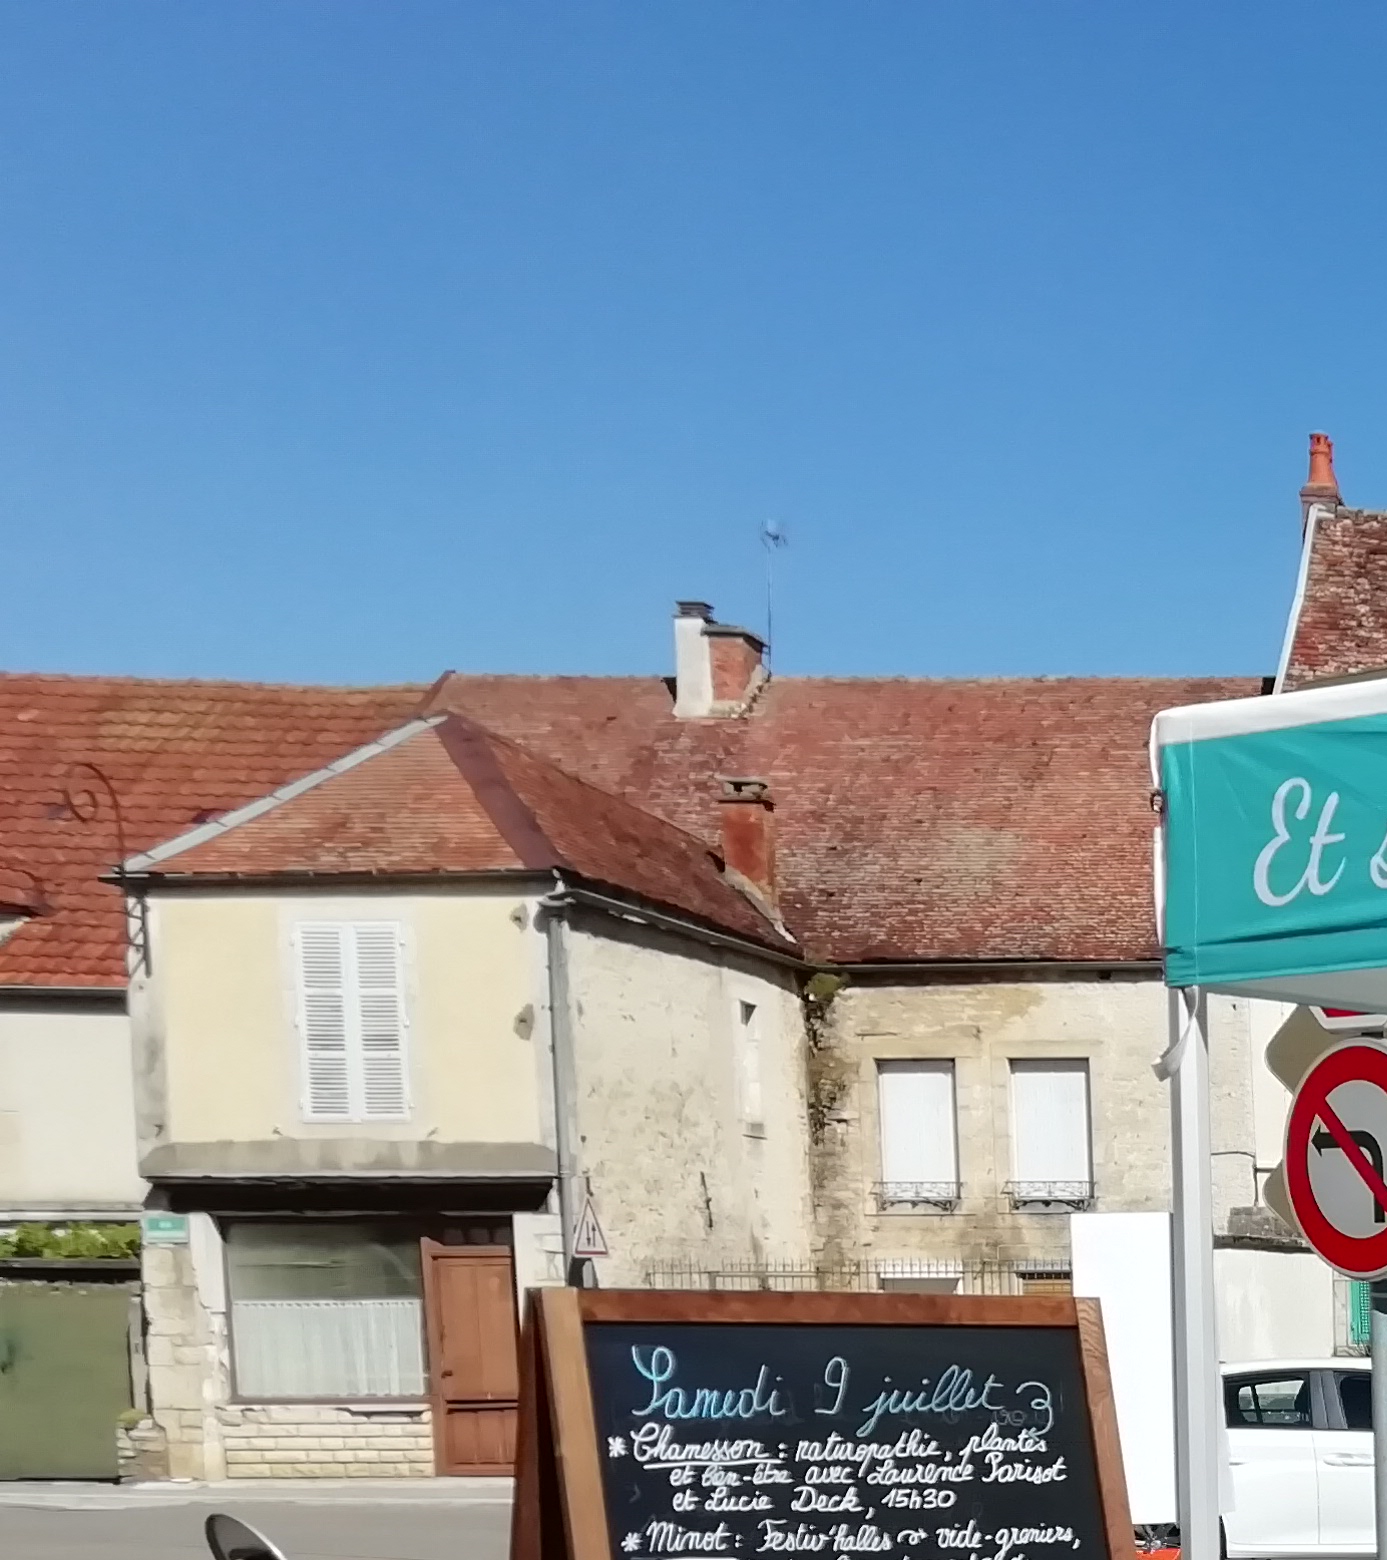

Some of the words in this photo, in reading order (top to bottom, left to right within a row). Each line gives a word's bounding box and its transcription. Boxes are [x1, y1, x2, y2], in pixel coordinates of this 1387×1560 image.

[1253, 777, 1347, 906] Et
[631, 1345, 785, 1418] Samedi
[815, 1356, 847, 1414] 9
[857, 1365, 1005, 1436] juillet
[960, 1430, 1047, 1465] plantes
[671, 1465, 696, 1485] et
[804, 1463, 854, 1483] avec
[867, 1458, 975, 1484] Laurence
[980, 1458, 1068, 1484] Parisot
[672, 1489, 698, 1511] et
[704, 1487, 774, 1511] Lucie
[881, 1489, 956, 1508] 15h30
